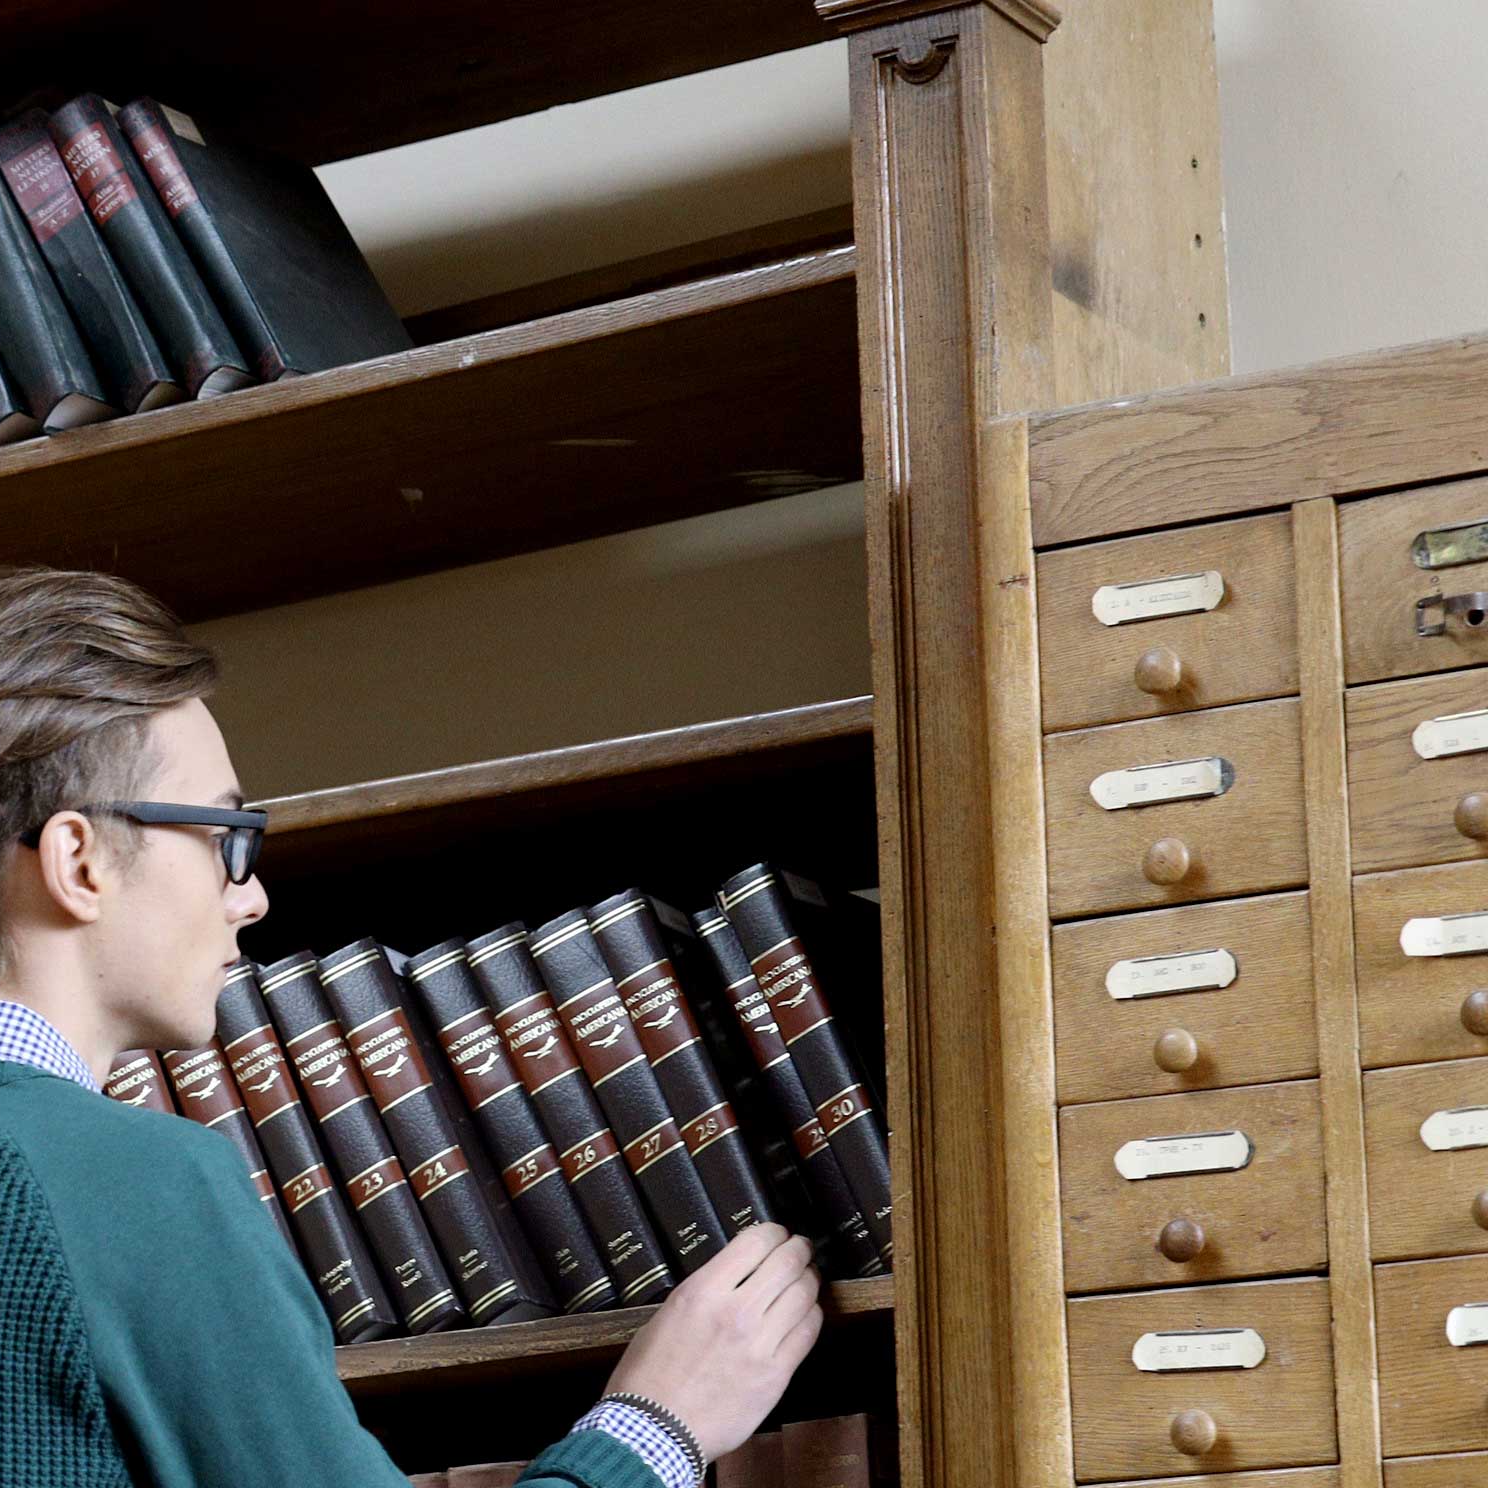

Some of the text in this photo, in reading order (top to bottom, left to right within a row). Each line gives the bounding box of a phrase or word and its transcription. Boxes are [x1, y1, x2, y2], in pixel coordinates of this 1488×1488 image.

[64, 130, 103, 162] MEYERS
[70, 139, 105, 168] NEUES
[9, 145, 52, 174] MEYERS
[16, 155, 53, 182] NEUES
[72, 146, 113, 182] LEXIKON
[16, 161, 61, 193] LEXIKON
[734, 992, 764, 1012] ENCYCL
[741, 1003, 770, 1025] AMERI
[575, 1006, 629, 1042] AMERICANA
[830, 1098, 855, 1123] 30
[695, 1117, 720, 1141] 28
[573, 1144, 597, 1170] 26
[640, 1134, 661, 1159] 27
[361, 1172, 384, 1197] 23
[424, 1161, 448, 1187] 24
[516, 1159, 539, 1184] 25
[293, 1178, 315, 1201] 22
